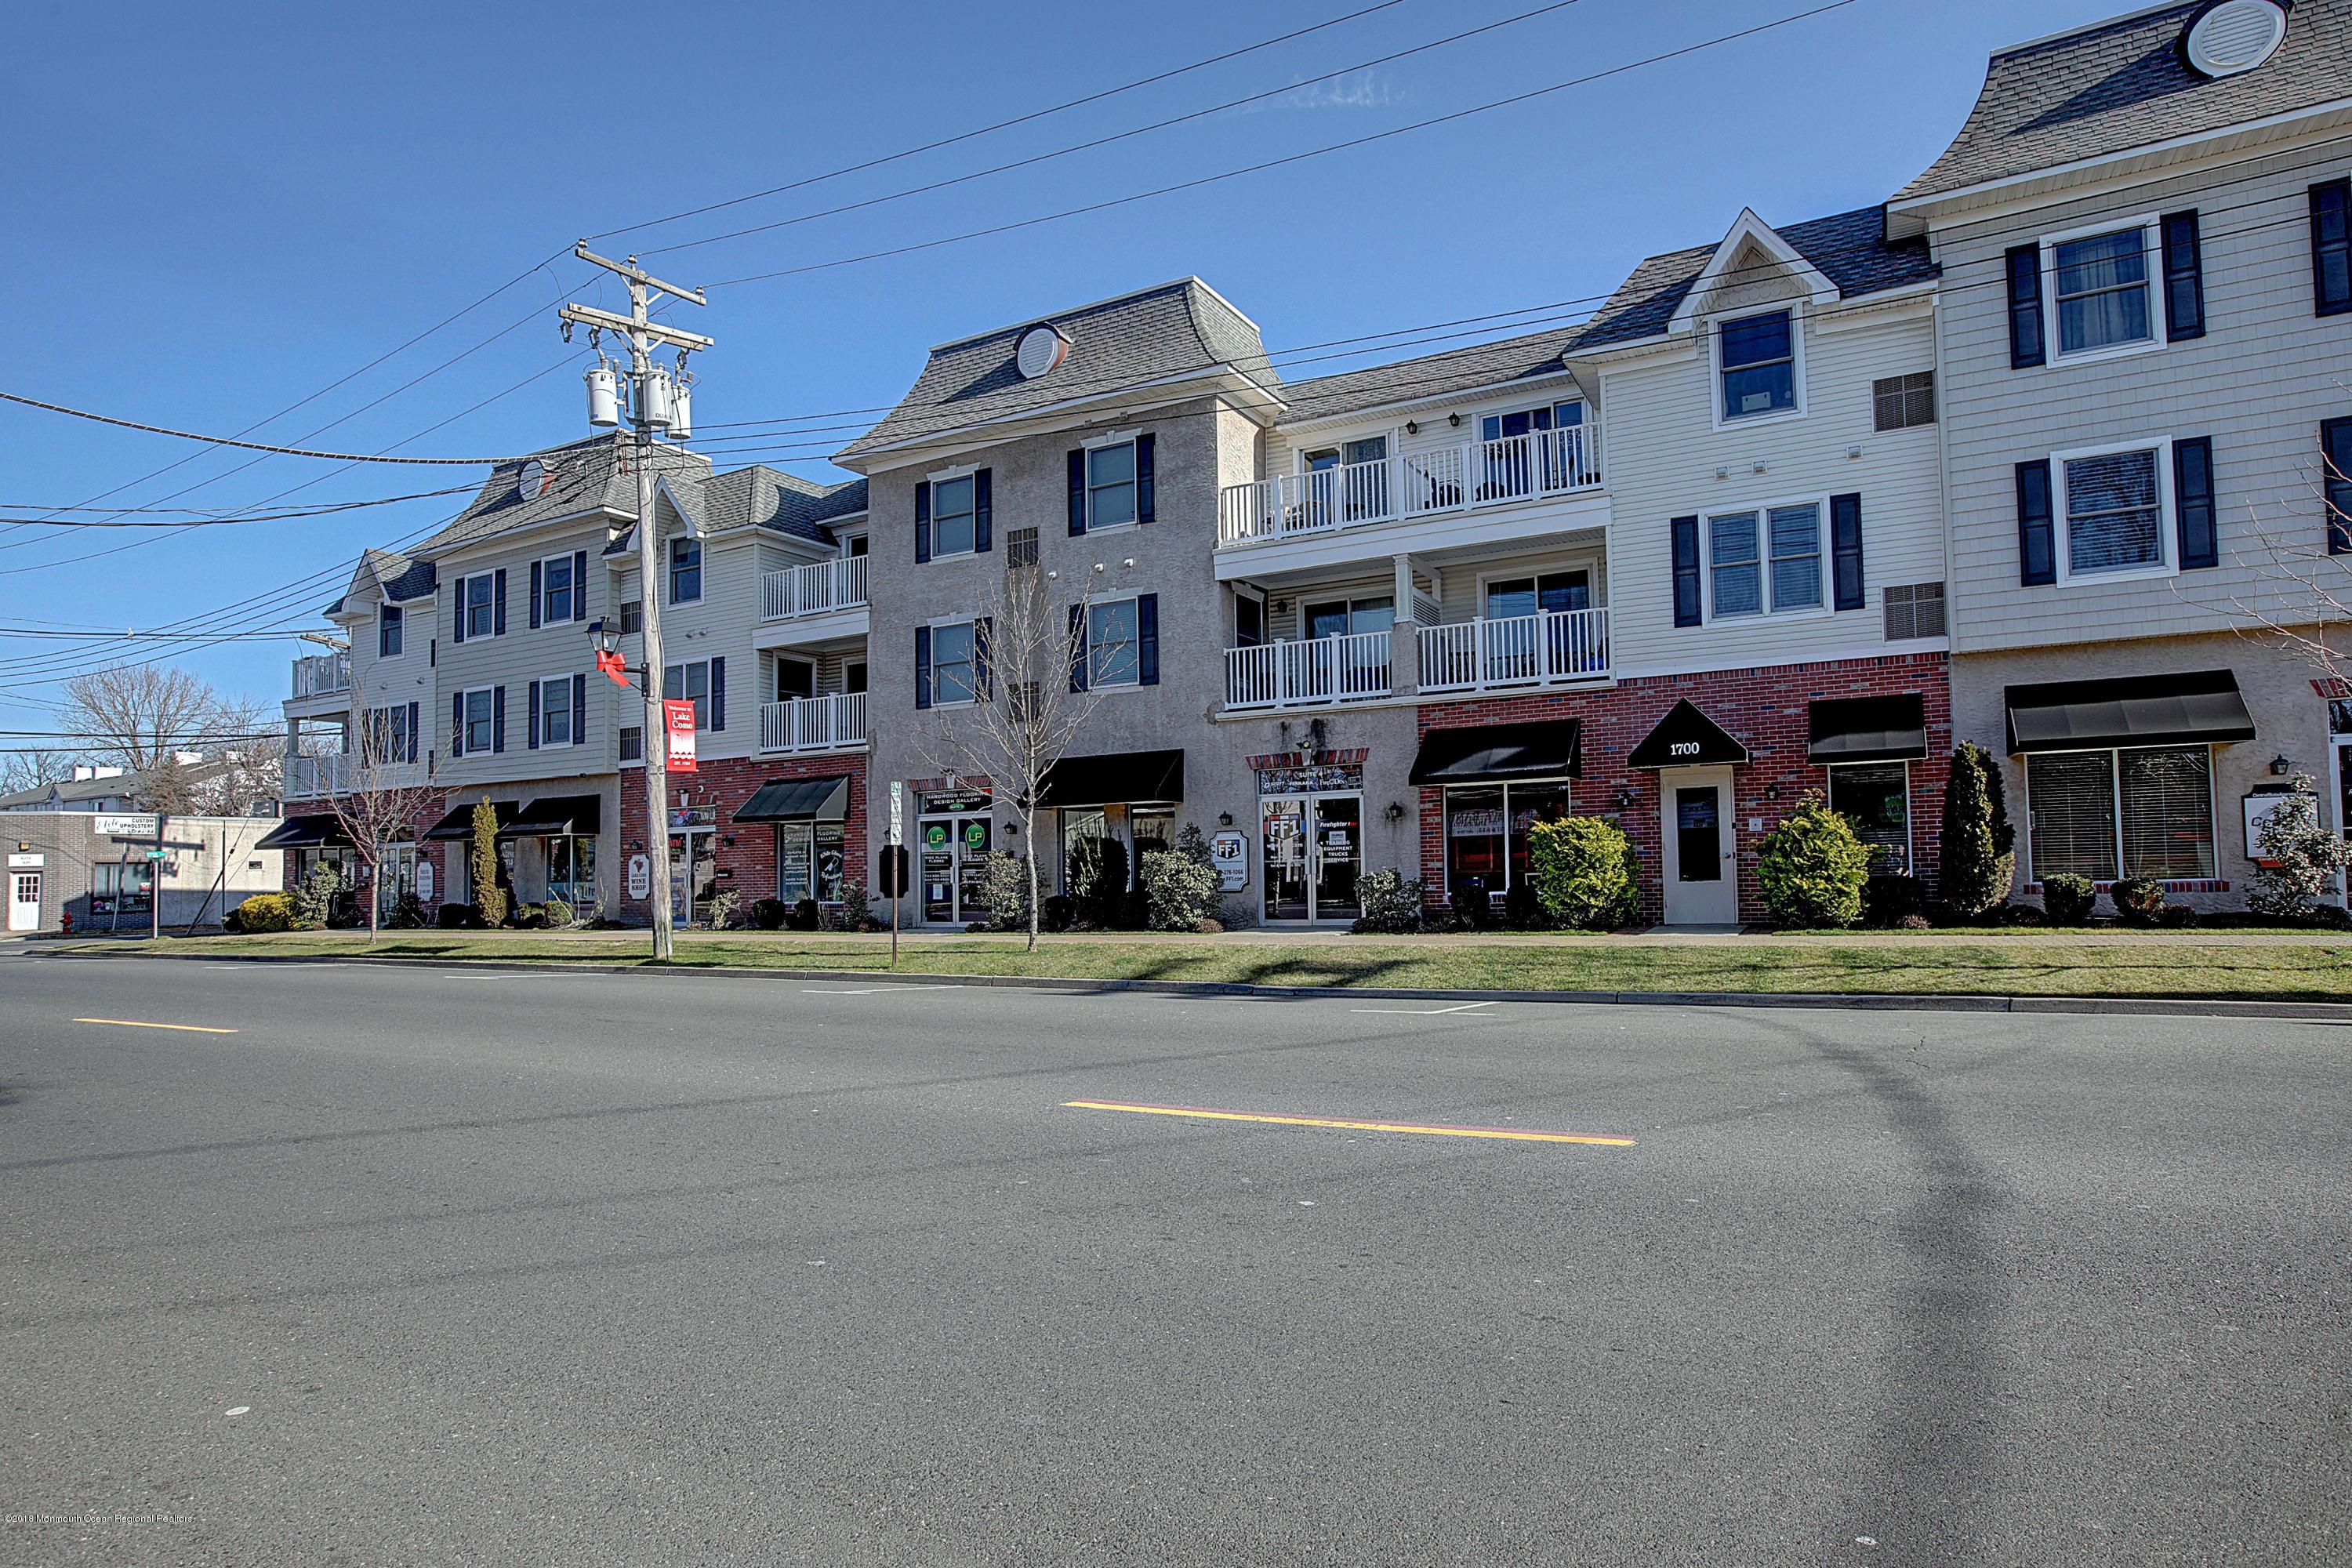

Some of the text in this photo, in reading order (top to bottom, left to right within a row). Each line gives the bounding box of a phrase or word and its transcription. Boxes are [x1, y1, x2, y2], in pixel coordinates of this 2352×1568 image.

[672, 711, 690, 720] Lake
[672, 720, 692, 729] Como
[1670, 742, 1700, 755] 1700
[1270, 819, 1299, 839] FF1
[930, 834, 943, 844] LP
[969, 832, 982, 842] LP
[820, 851, 831, 859] White
[1218, 844, 1240, 858] FF1
